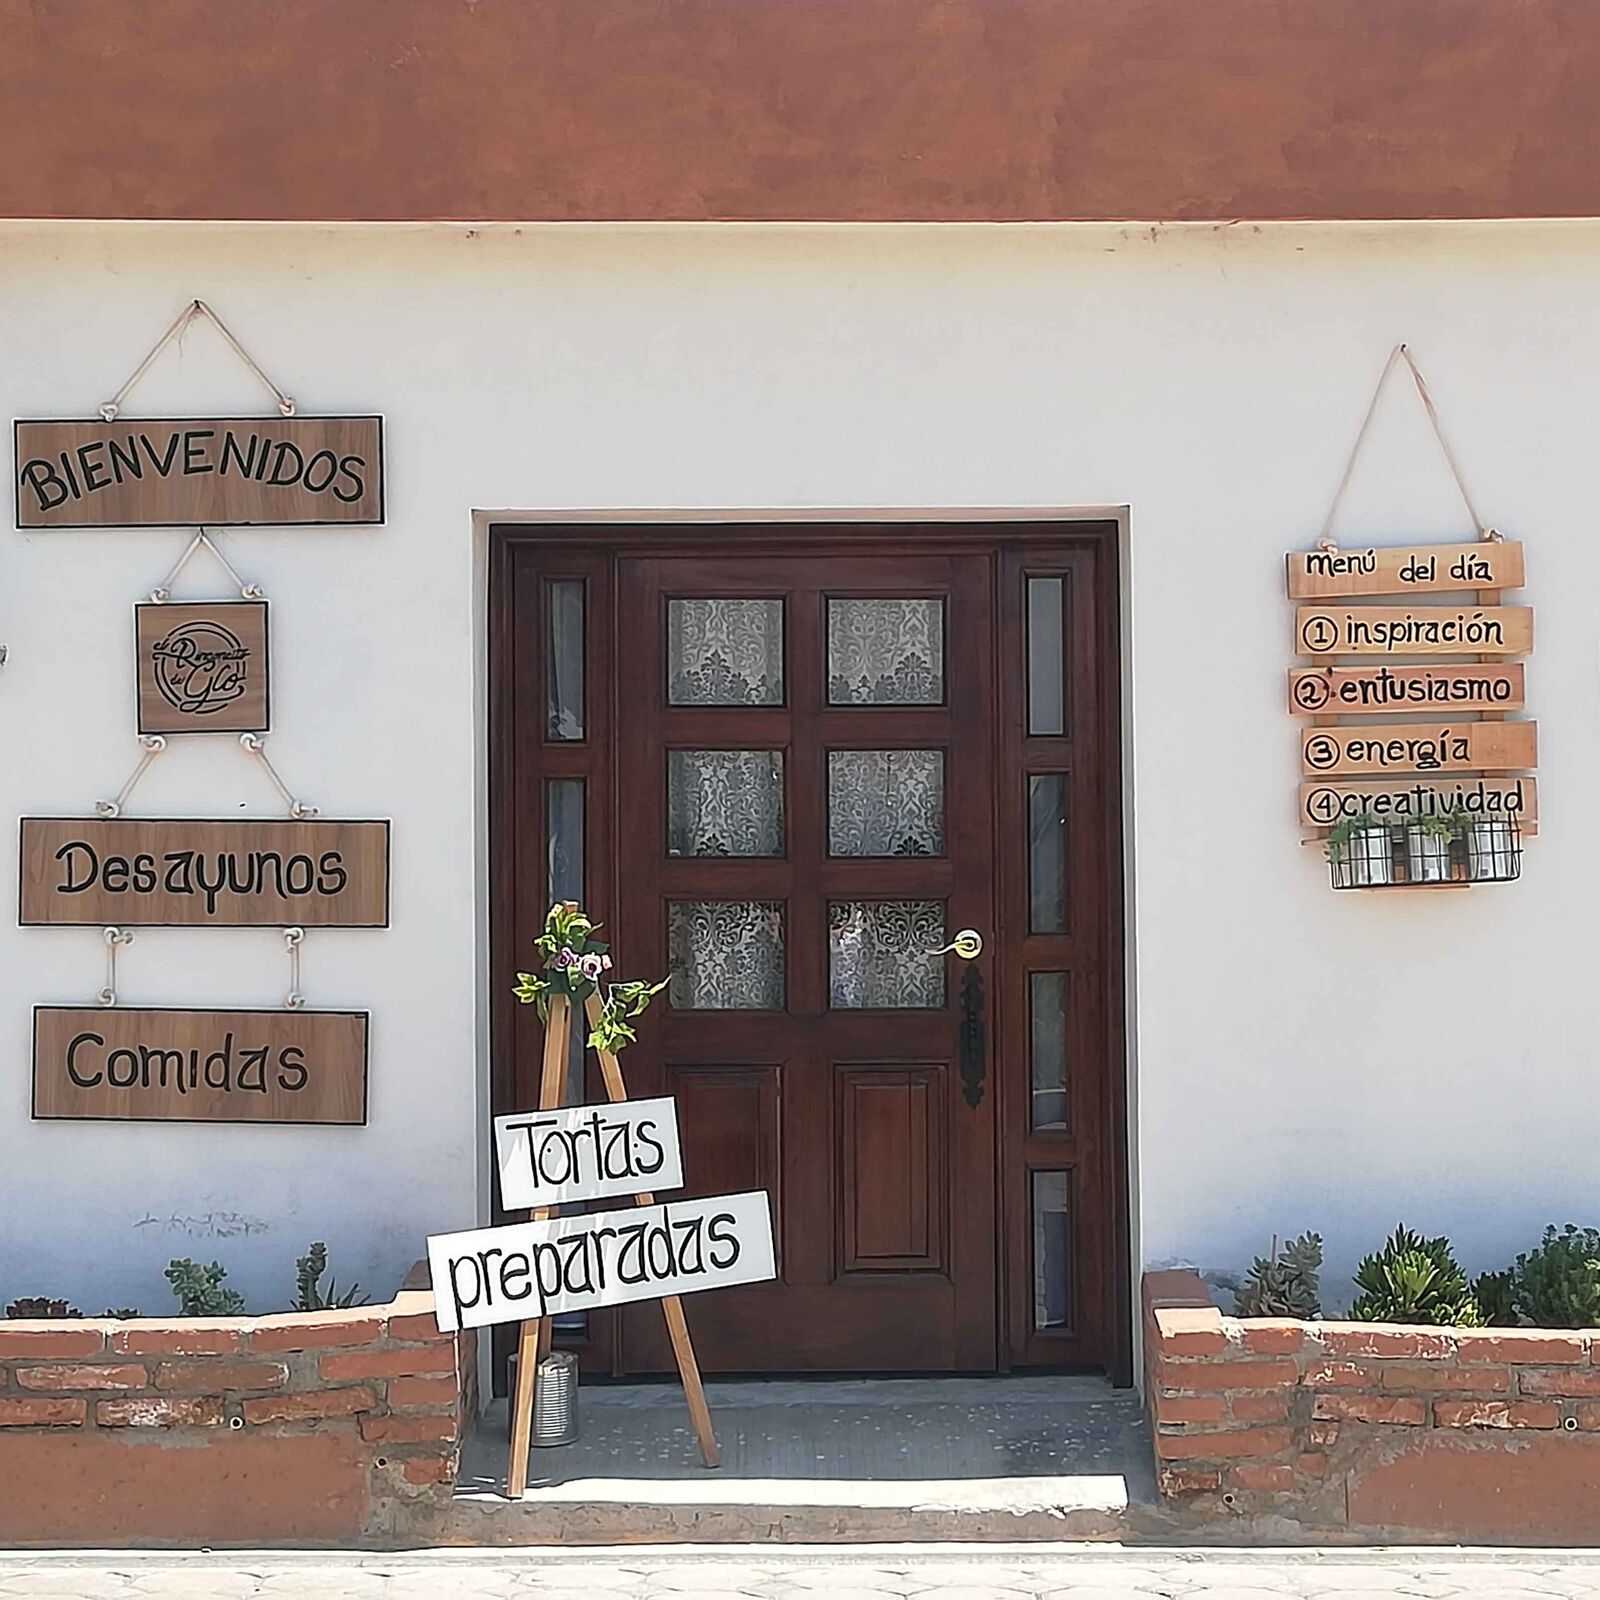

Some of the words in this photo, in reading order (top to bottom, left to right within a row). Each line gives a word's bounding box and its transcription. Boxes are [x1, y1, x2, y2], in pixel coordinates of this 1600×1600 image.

[20, 430, 366, 511] BIENVENIDOS
[1306, 550, 1376, 577] menú
[1399, 555, 1436, 583] del
[1450, 554, 1493, 582] día
[1346, 613, 1504, 651] inspiración
[1339, 667, 1511, 704] entusiasmo
[1346, 730, 1471, 769] energía
[1340, 780, 1524, 816] creatividad
[55, 841, 348, 915] Desayunos
[66, 1032, 309, 1095] Comidas
[505, 1111, 665, 1189] Tortas
[448, 1205, 741, 1330] preparadas
